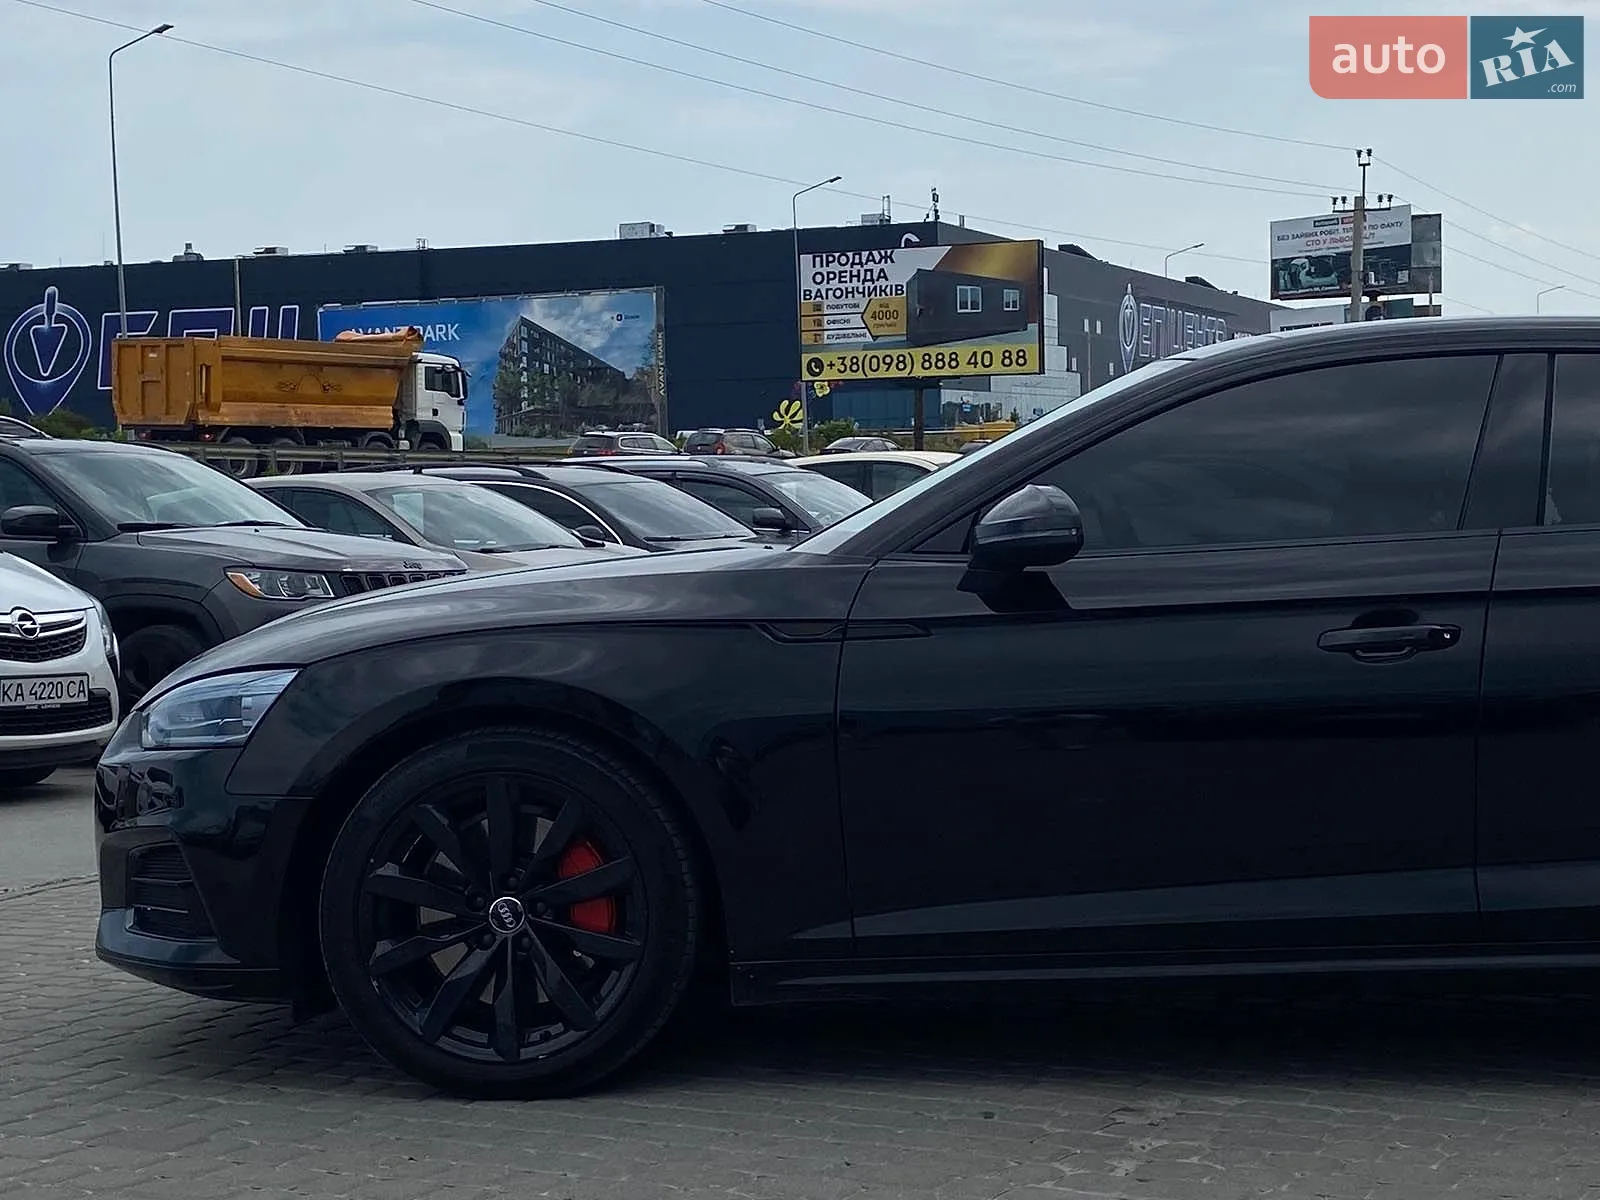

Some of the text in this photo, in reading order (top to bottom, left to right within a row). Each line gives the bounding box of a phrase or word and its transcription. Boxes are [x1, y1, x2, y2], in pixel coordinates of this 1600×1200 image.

[812, 250, 895, 268] ПРОДАЖ
[812, 268, 889, 285] ОРЕНДА
[803, 284, 905, 301] ВАГОНЧИКІВ
[870, 309, 899, 320] 4000
[827, 349, 1028, 377] +38(098) 888 40 88
[2, 680, 86, 702] KA 4220 CA
